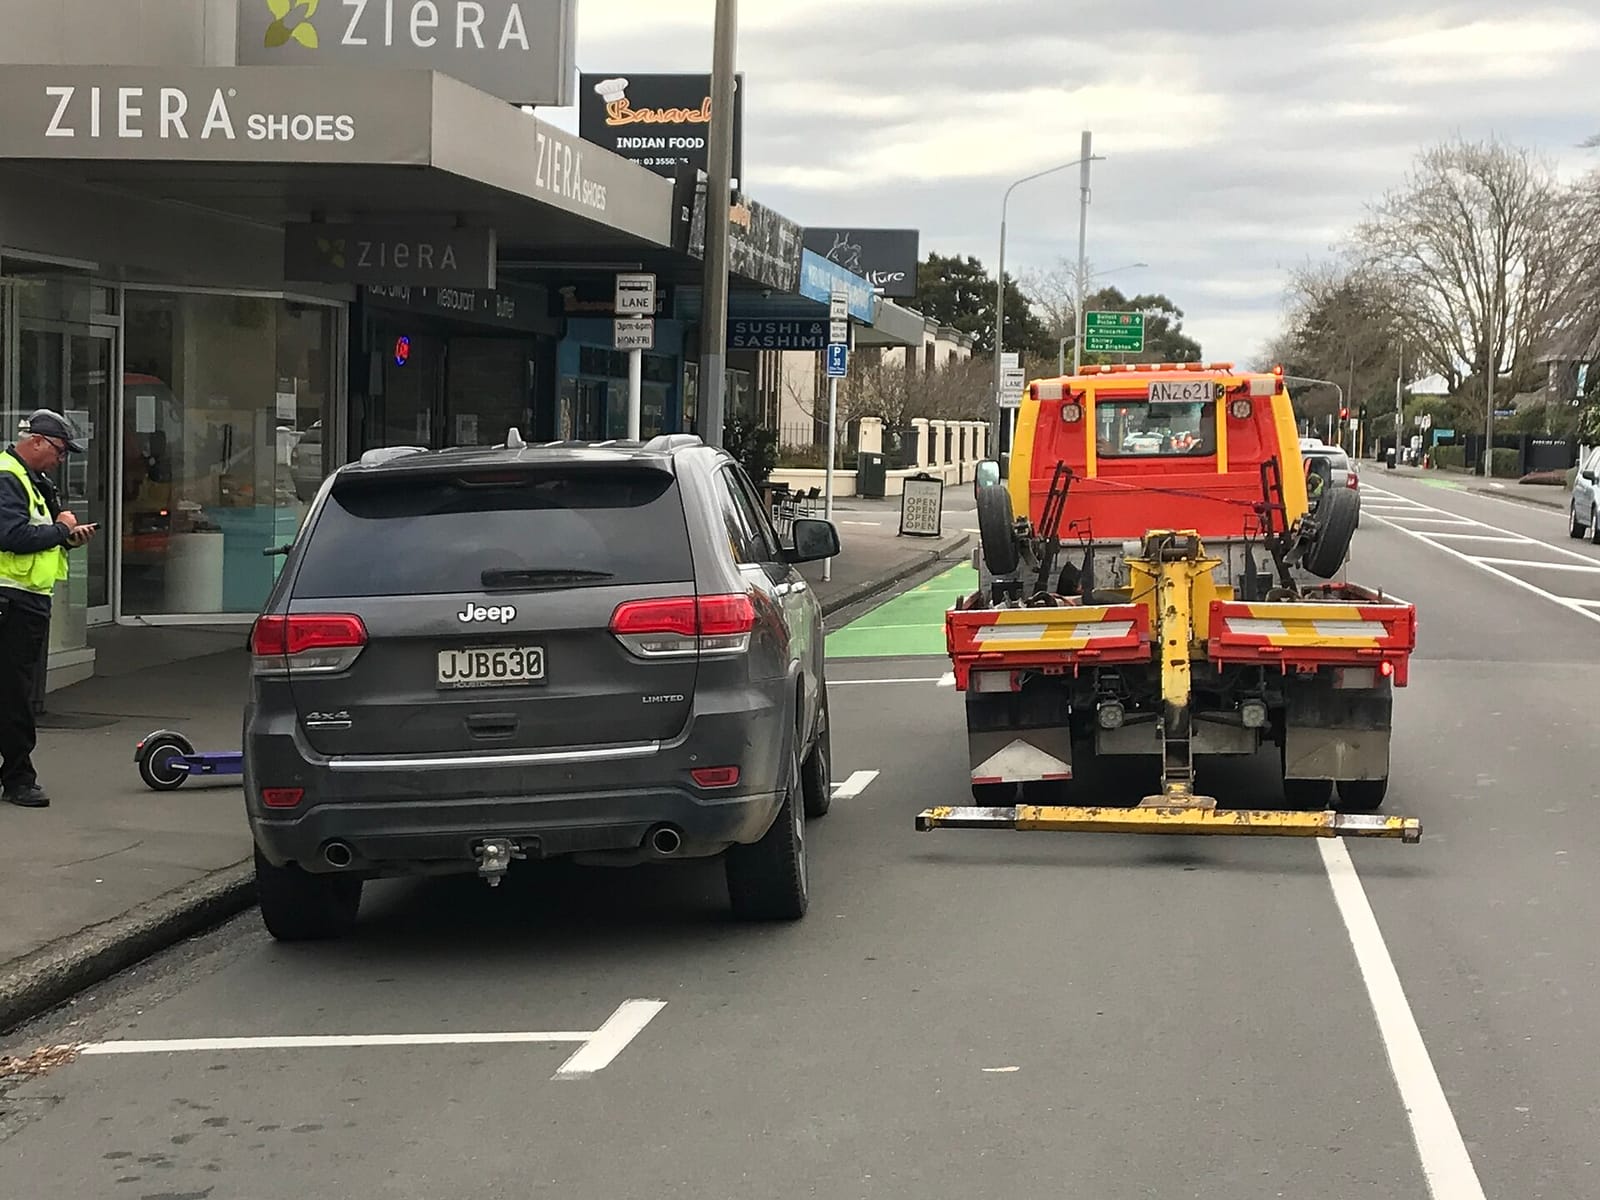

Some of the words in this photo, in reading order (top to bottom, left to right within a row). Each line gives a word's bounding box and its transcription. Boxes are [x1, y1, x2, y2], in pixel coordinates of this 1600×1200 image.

[247, 114, 355, 141] SHOES
[616, 137, 666, 149] INDIAN
[668, 137, 705, 149] FOOD
[643, 157, 654, 165] 03
[535, 133, 582, 202] ZIERA
[582, 179, 607, 211] SHOES
[621, 298, 649, 308] LANE
[735, 322, 800, 334] SUSHI
[810, 322, 823, 334] &
[733, 335, 824, 347] SASHIMI
[833, 347, 841, 357] P
[1151, 382, 1210, 401] ANZ621
[907, 497, 937, 506] OPEN
[907, 505, 936, 514] OPEN
[906, 513, 936, 522] OPEN
[905, 521, 935, 530] OPEN
[457, 602, 517, 625] Jeep
[441, 650, 542, 679] JJB630
[642, 694, 685, 703] LIMITED
